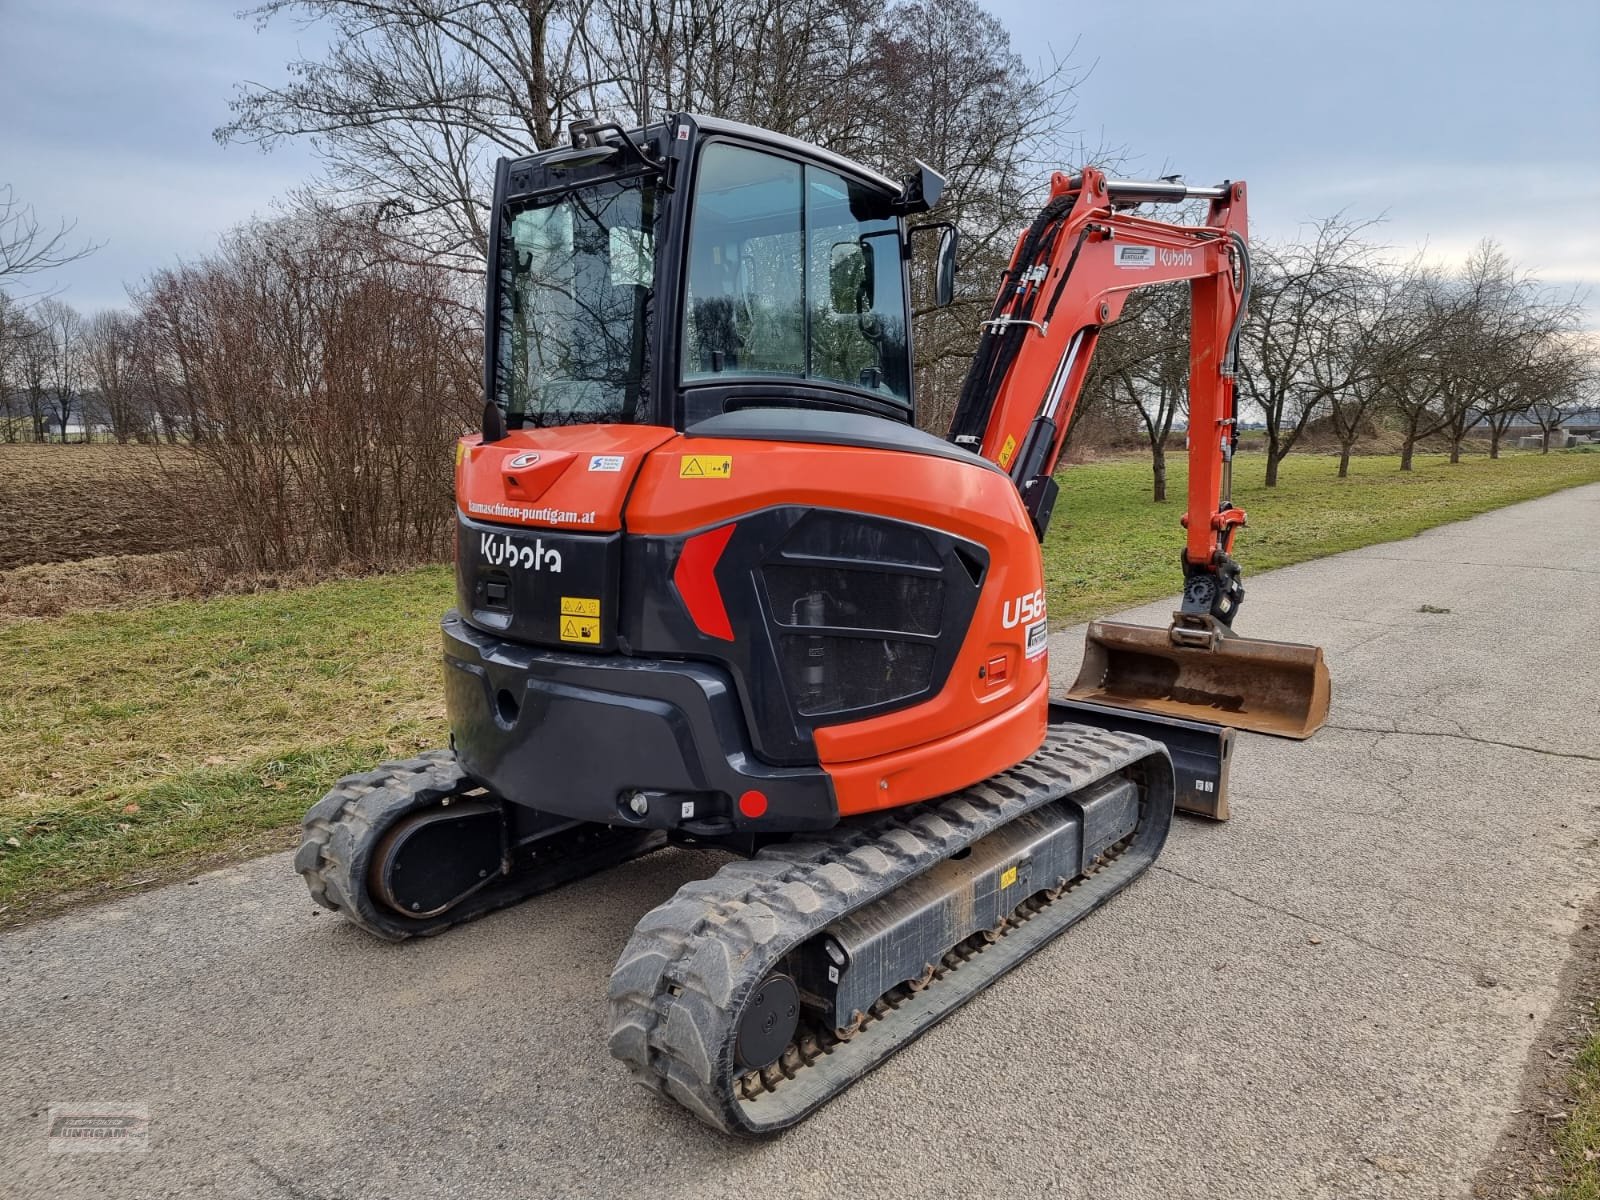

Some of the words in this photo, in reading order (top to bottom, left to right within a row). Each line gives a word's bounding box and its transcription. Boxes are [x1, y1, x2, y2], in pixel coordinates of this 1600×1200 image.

[1159, 248, 1193, 267] Kubota
[468, 500, 596, 525] baumaschinen-puntigam.at
[481, 533, 562, 573] Kubota
